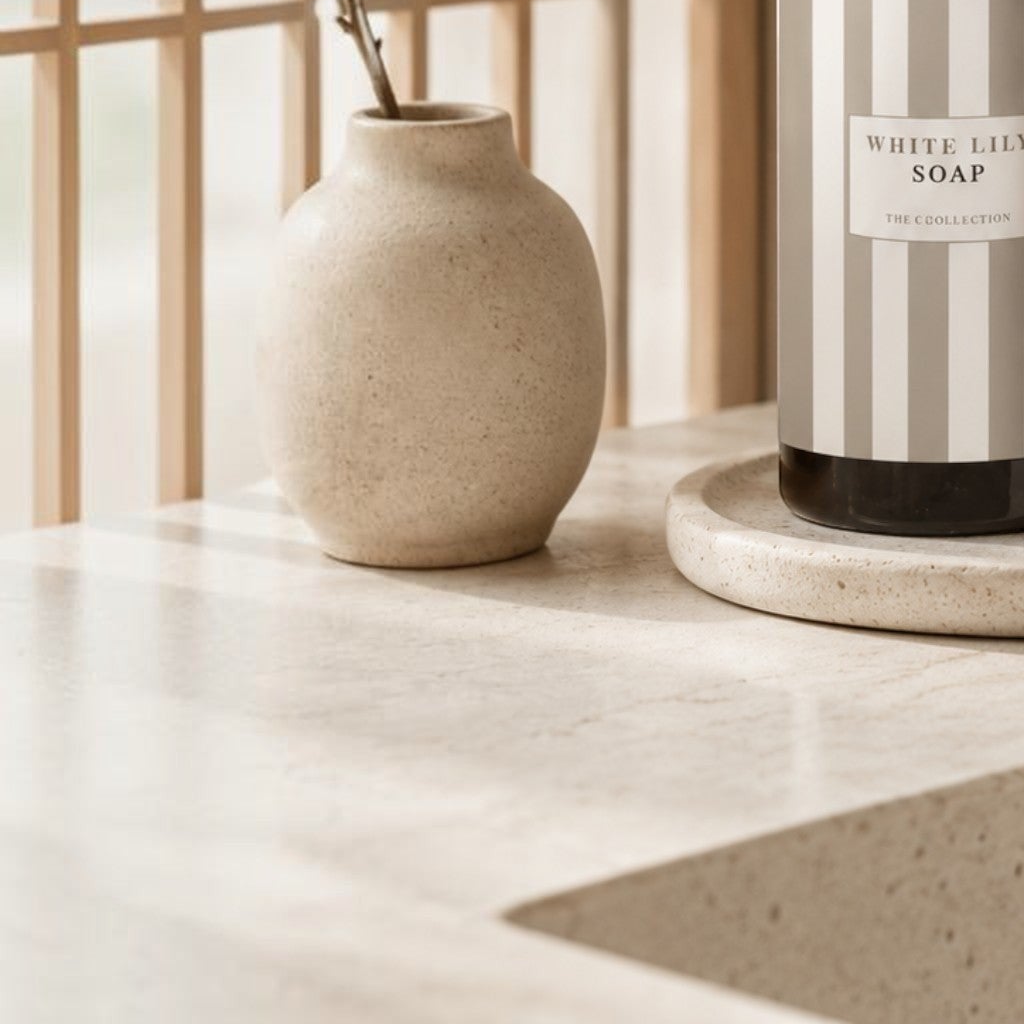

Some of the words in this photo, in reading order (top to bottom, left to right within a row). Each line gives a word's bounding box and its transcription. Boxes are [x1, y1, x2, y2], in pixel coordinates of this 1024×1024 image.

[867, 135, 956, 155] WHITE
[912, 164, 985, 183] SOAP
[885, 213, 914, 225] THE
